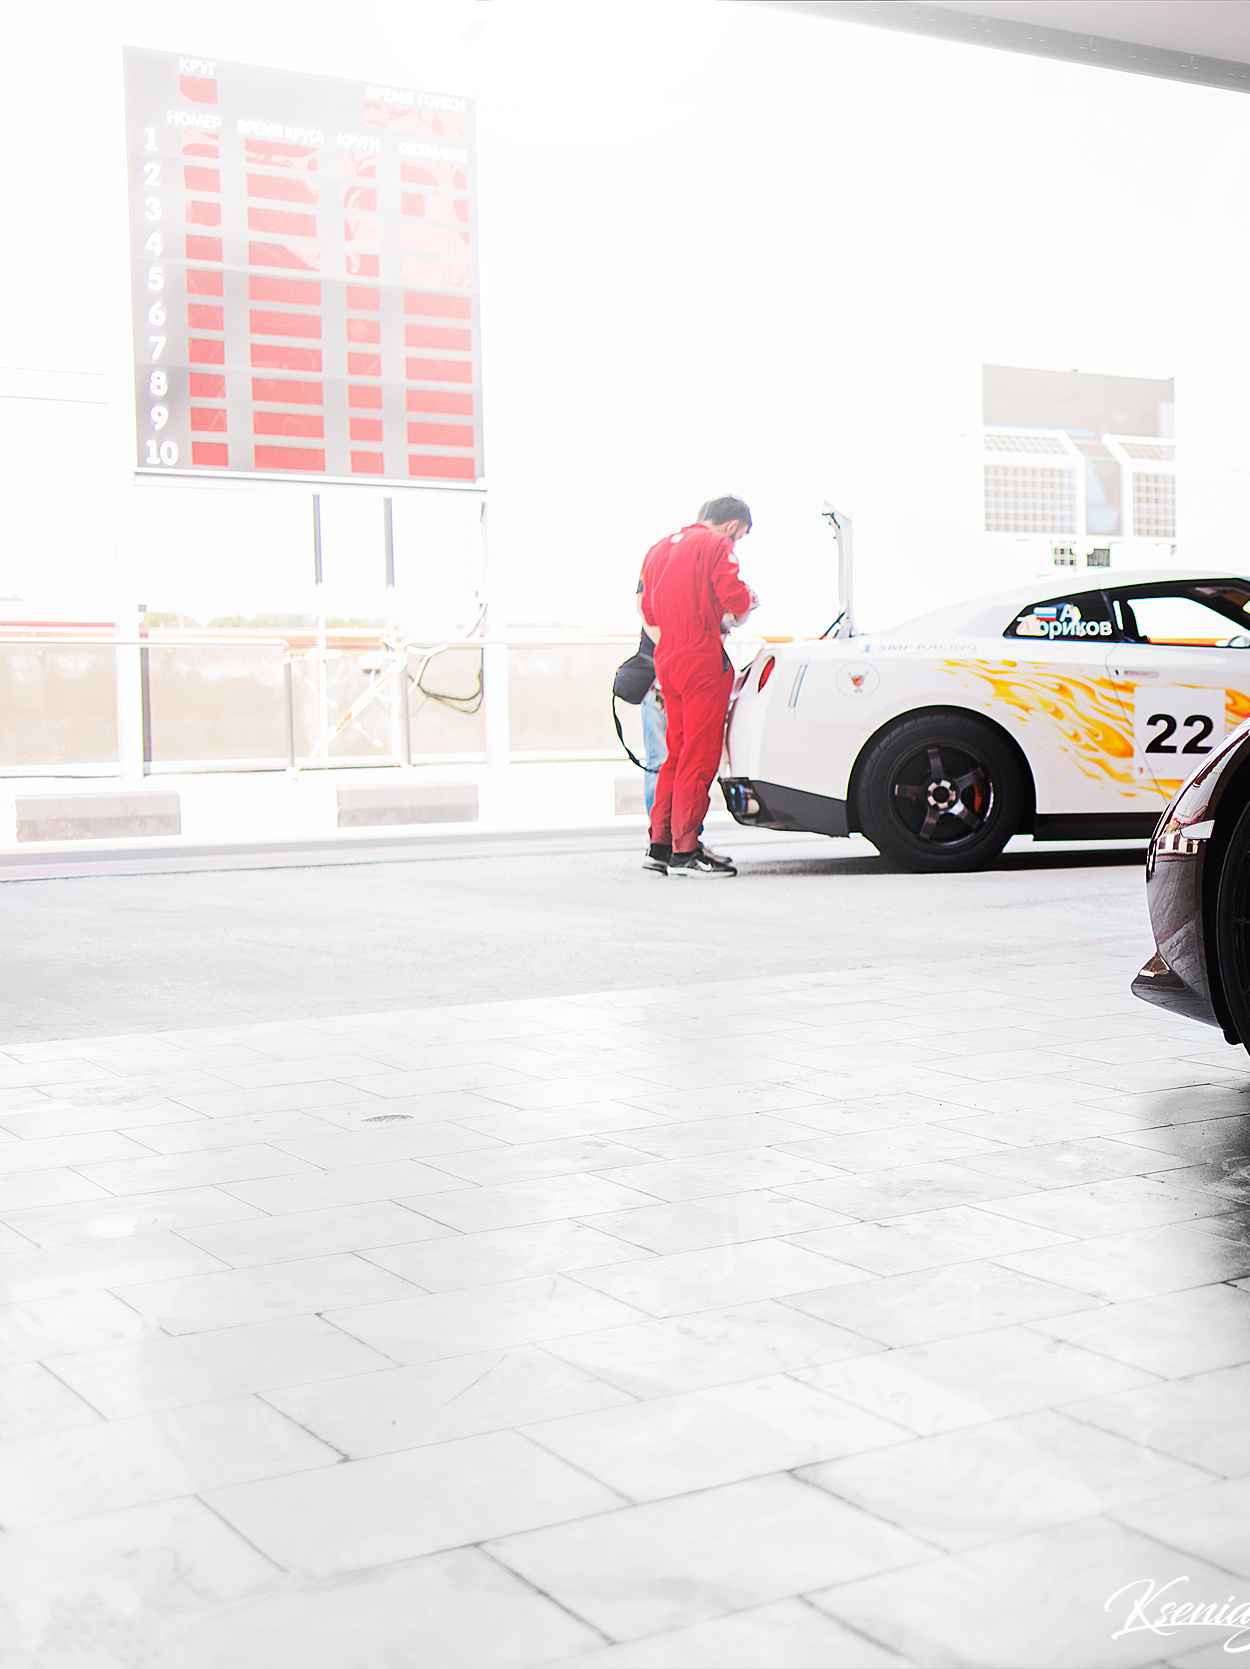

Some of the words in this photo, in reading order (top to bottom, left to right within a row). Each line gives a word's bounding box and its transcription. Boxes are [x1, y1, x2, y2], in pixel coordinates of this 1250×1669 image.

[179, 57, 217, 76] КРУГ
[365, 85, 414, 105] ВРЕМЯ
[417, 93, 466, 113] ГОНКИ
[167, 110, 222, 130] НОМЕР
[237, 119, 283, 139] ВРЕМЯ
[285, 125, 324, 145] КРУГА
[144, 127, 159, 152] 1
[337, 133, 381, 152] КРУГИ
[143, 162, 161, 187] 2
[145, 197, 162, 222] 3
[144, 232, 163, 257] 4
[147, 267, 165, 291] 5
[148, 302, 166, 326] 6
[149, 336, 166, 361] 7
[149, 371, 168, 396] 8
[150, 405, 169, 430] 9
[146, 439, 179, 465] 10
[1145, 713, 1214, 754] 22
